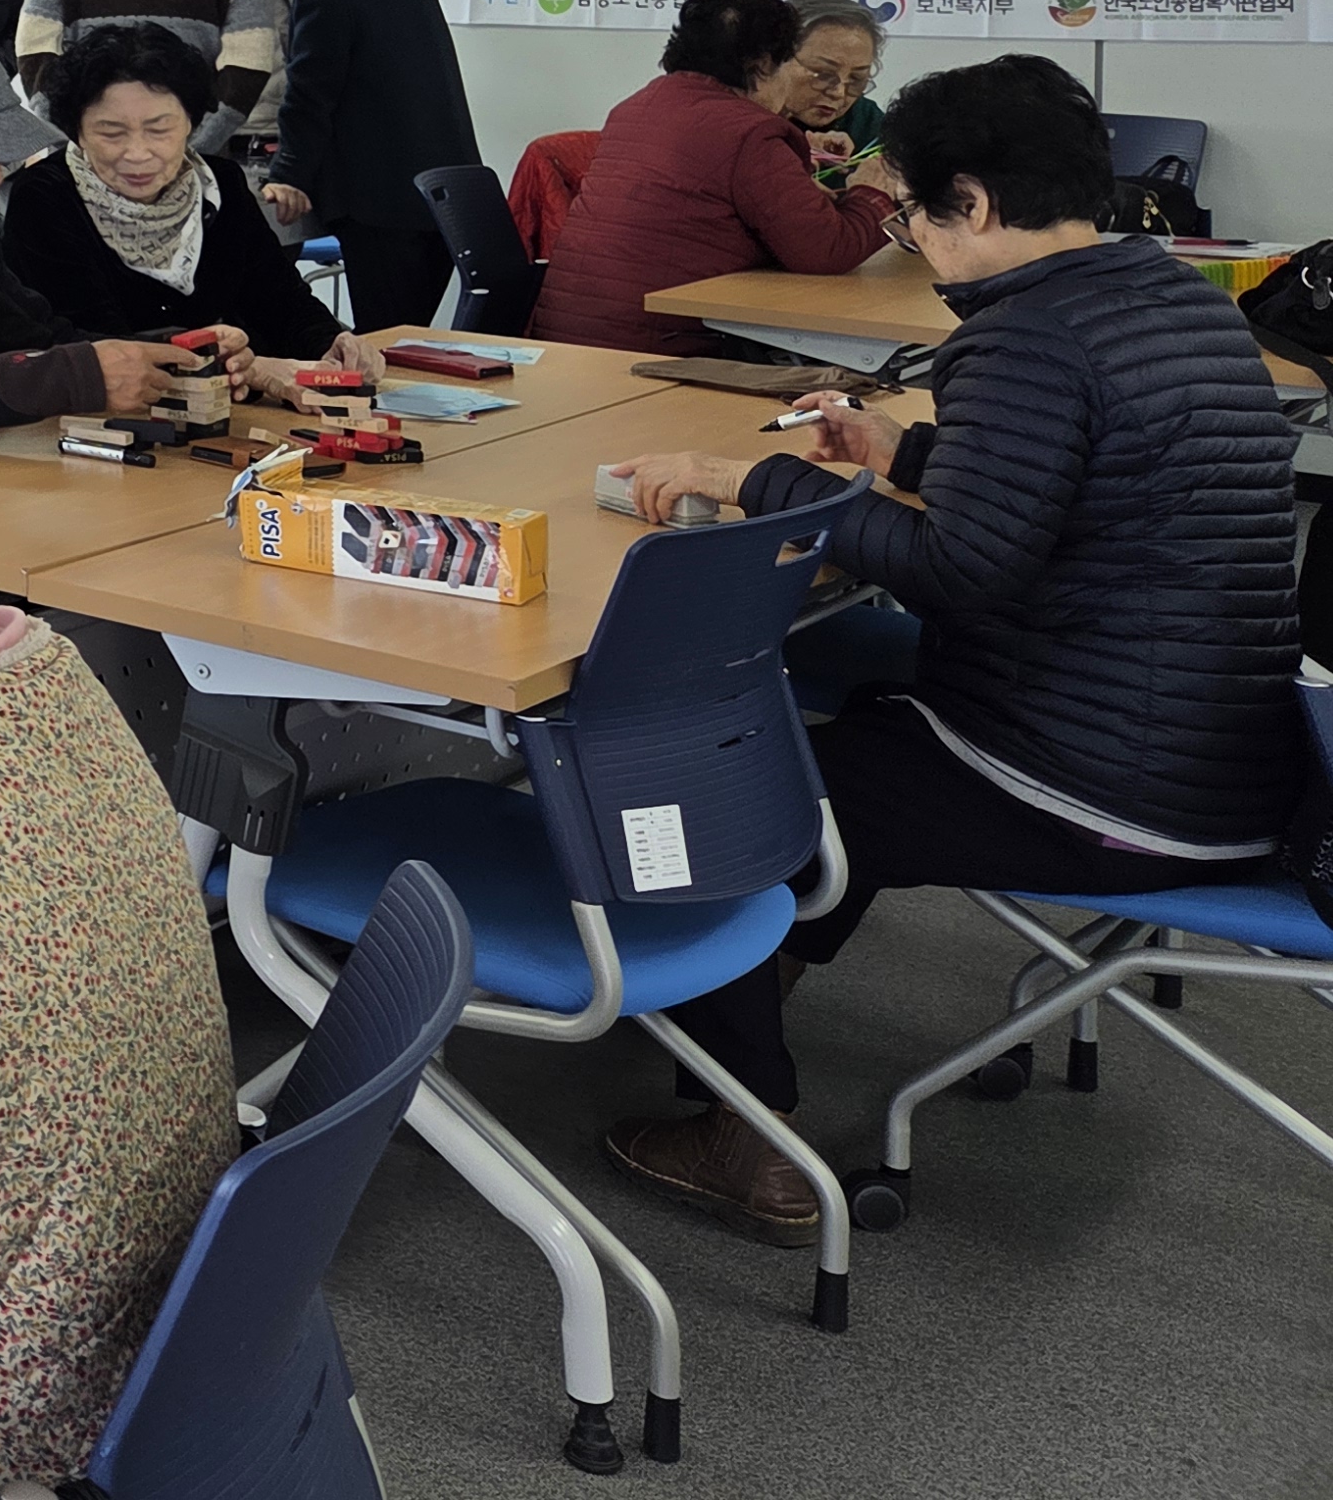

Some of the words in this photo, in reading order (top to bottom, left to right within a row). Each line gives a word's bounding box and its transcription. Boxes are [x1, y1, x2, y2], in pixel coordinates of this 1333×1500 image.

[314, 375, 341, 385] PISA
[336, 437, 360, 449] PISA
[259, 508, 282, 558] PISA
